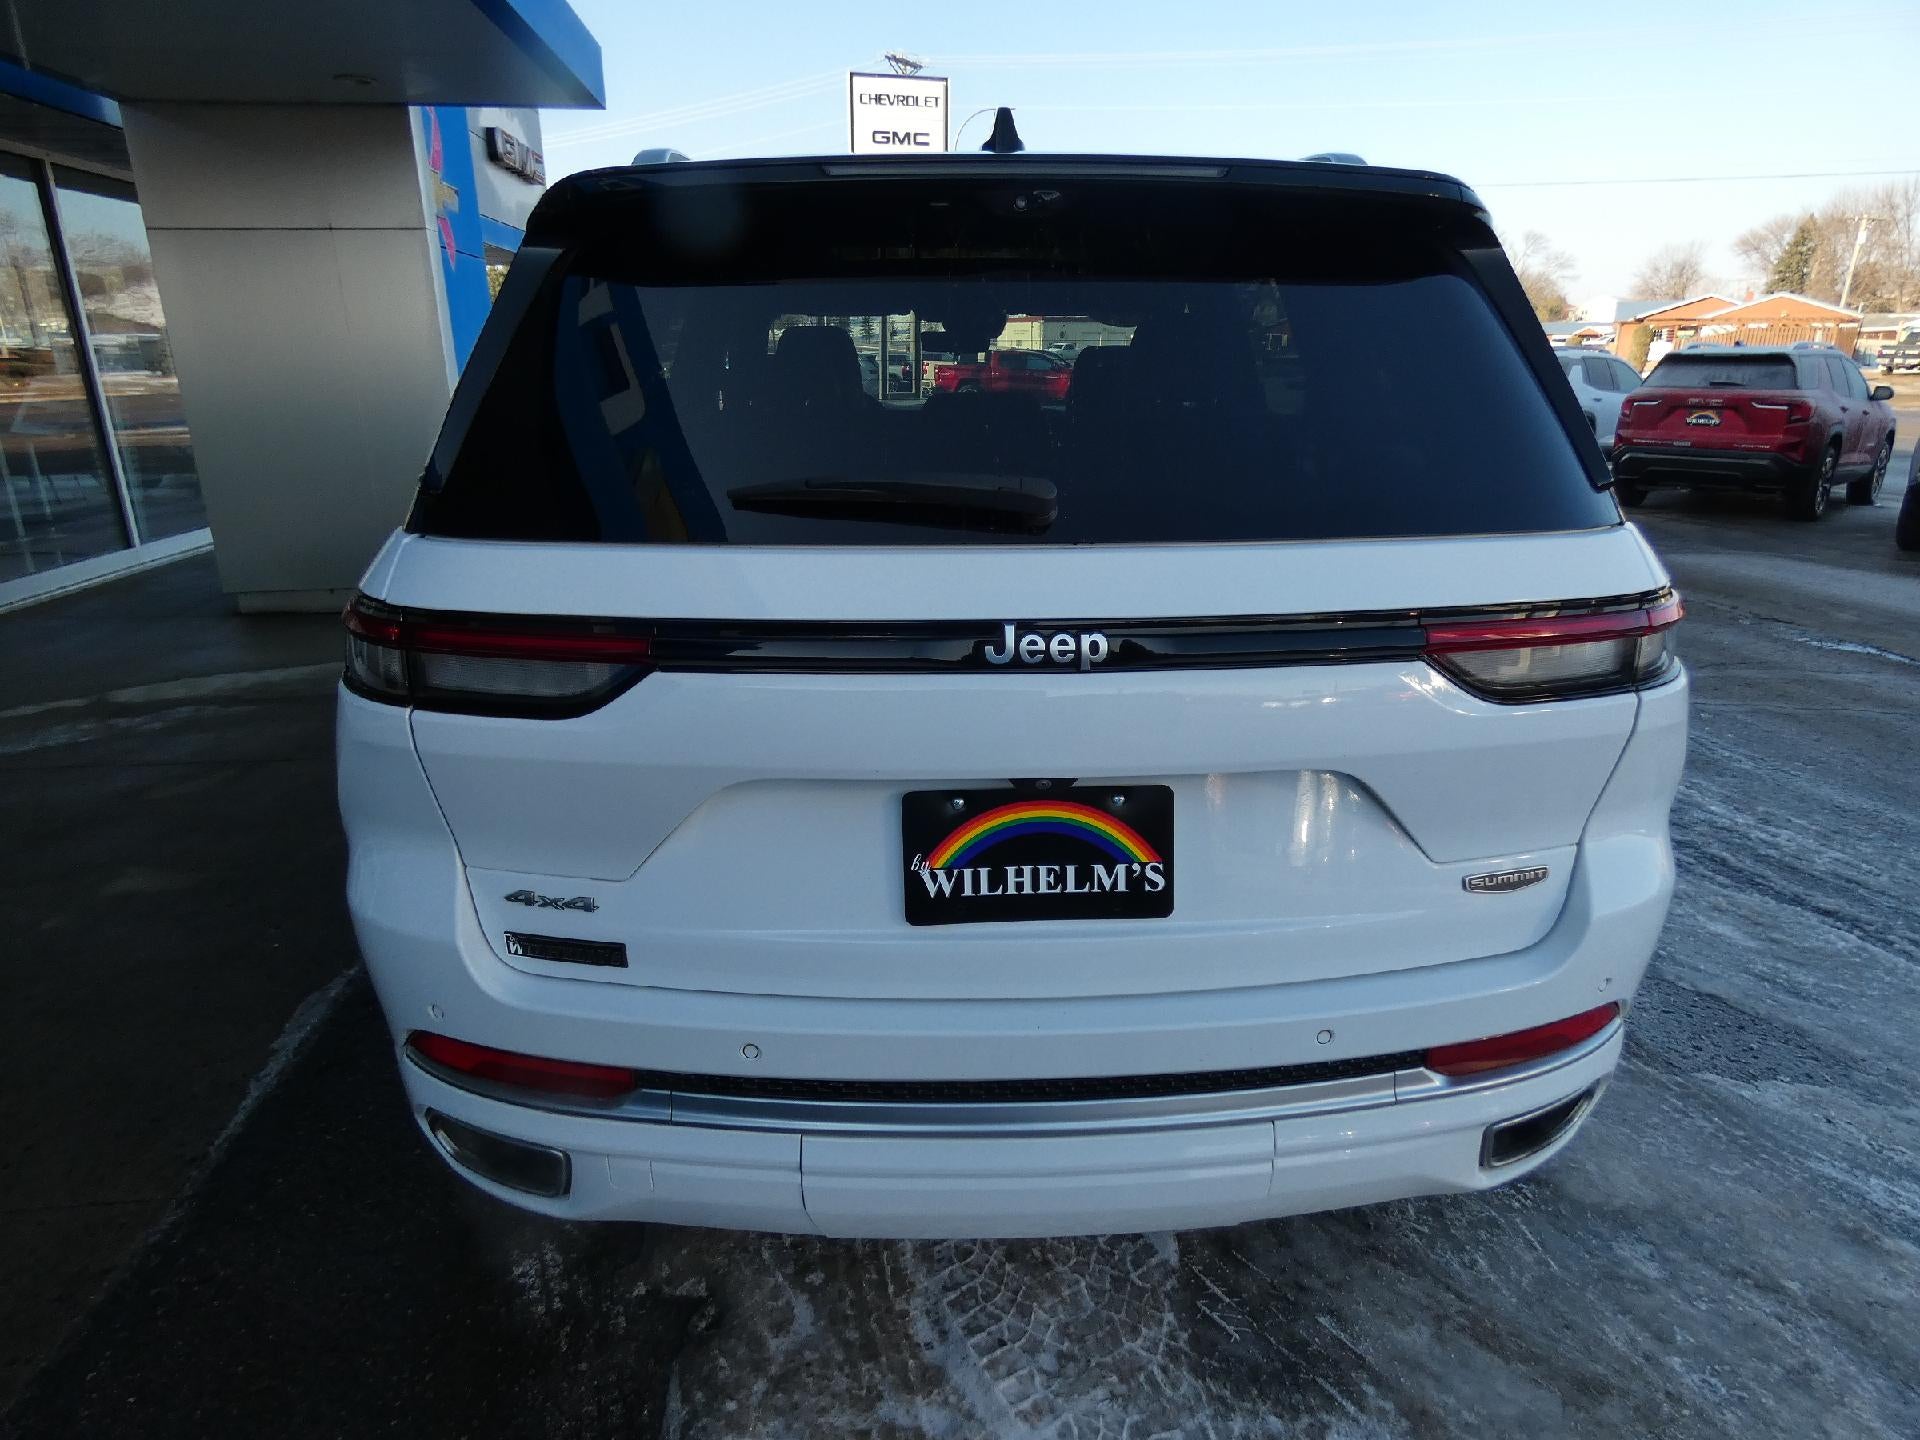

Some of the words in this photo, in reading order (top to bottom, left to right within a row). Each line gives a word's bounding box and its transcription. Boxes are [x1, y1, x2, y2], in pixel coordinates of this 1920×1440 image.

[859, 93, 939, 108] CHEVROLET
[872, 130, 930, 147] GMC
[486, 127, 546, 186] GMC
[984, 623, 1108, 671] Jeep
[920, 862, 1165, 898] WILHELM'S
[1470, 869, 1547, 888] SUMMIT
